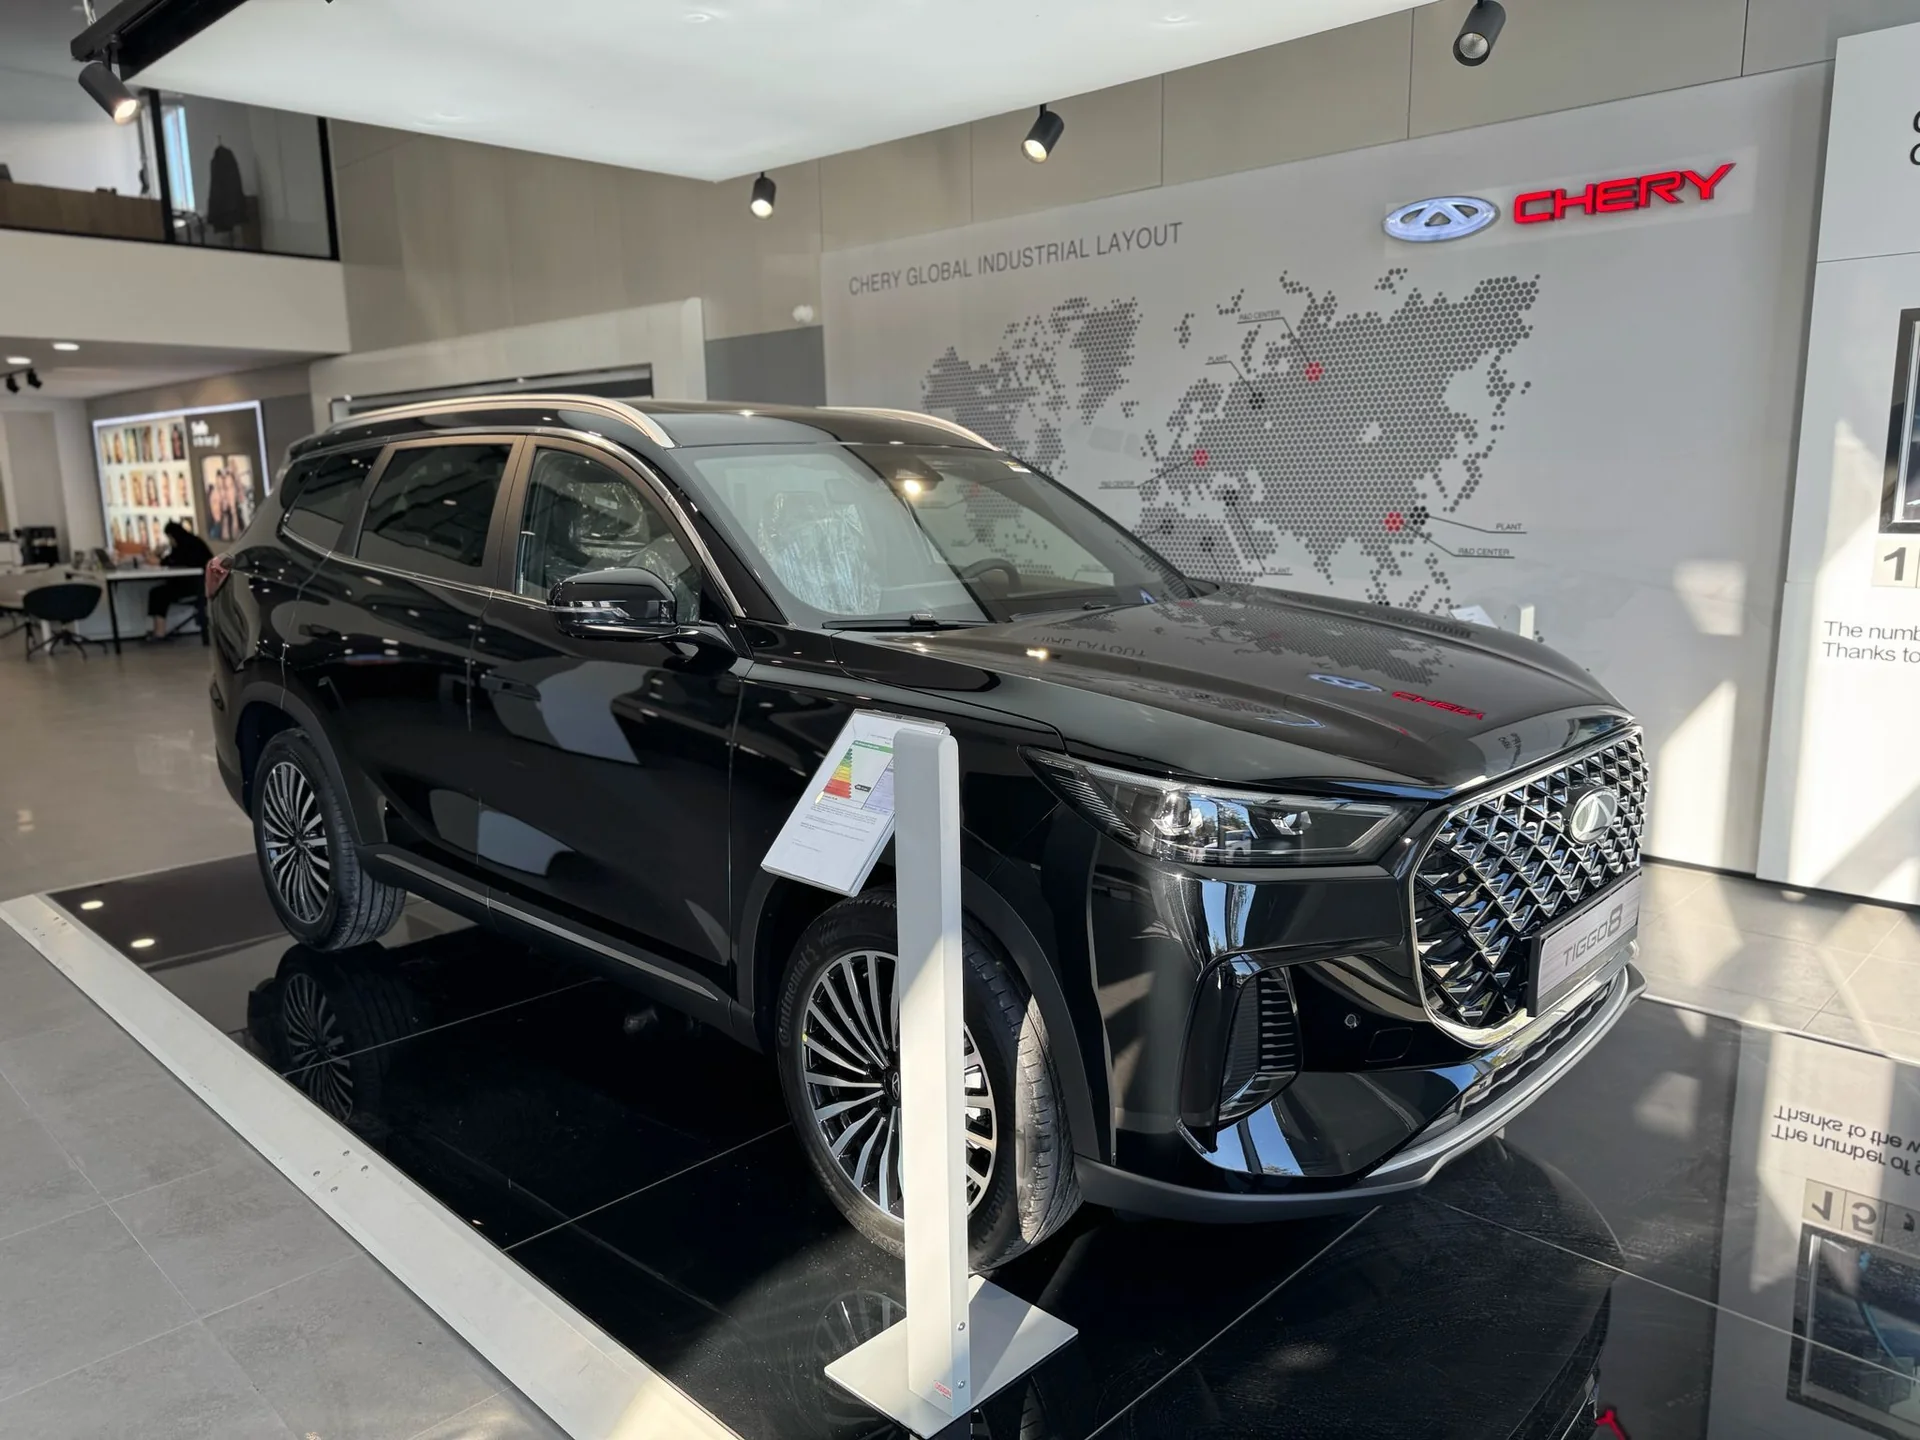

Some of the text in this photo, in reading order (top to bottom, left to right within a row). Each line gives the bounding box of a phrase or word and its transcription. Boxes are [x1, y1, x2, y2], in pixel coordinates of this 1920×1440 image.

[1513, 162, 1737, 225] CHERY
[849, 221, 1183, 296] CHERY GLOBAL INDUSTRIAL LAYOUT
[1254, 309, 1281, 319] CENTER
[1495, 522, 1522, 531] PLANT
[1476, 548, 1510, 556] CENTER
[1883, 546, 1907, 582] 1
[1824, 620, 1863, 638] The
[1822, 641, 1920, 664] Thanks to
